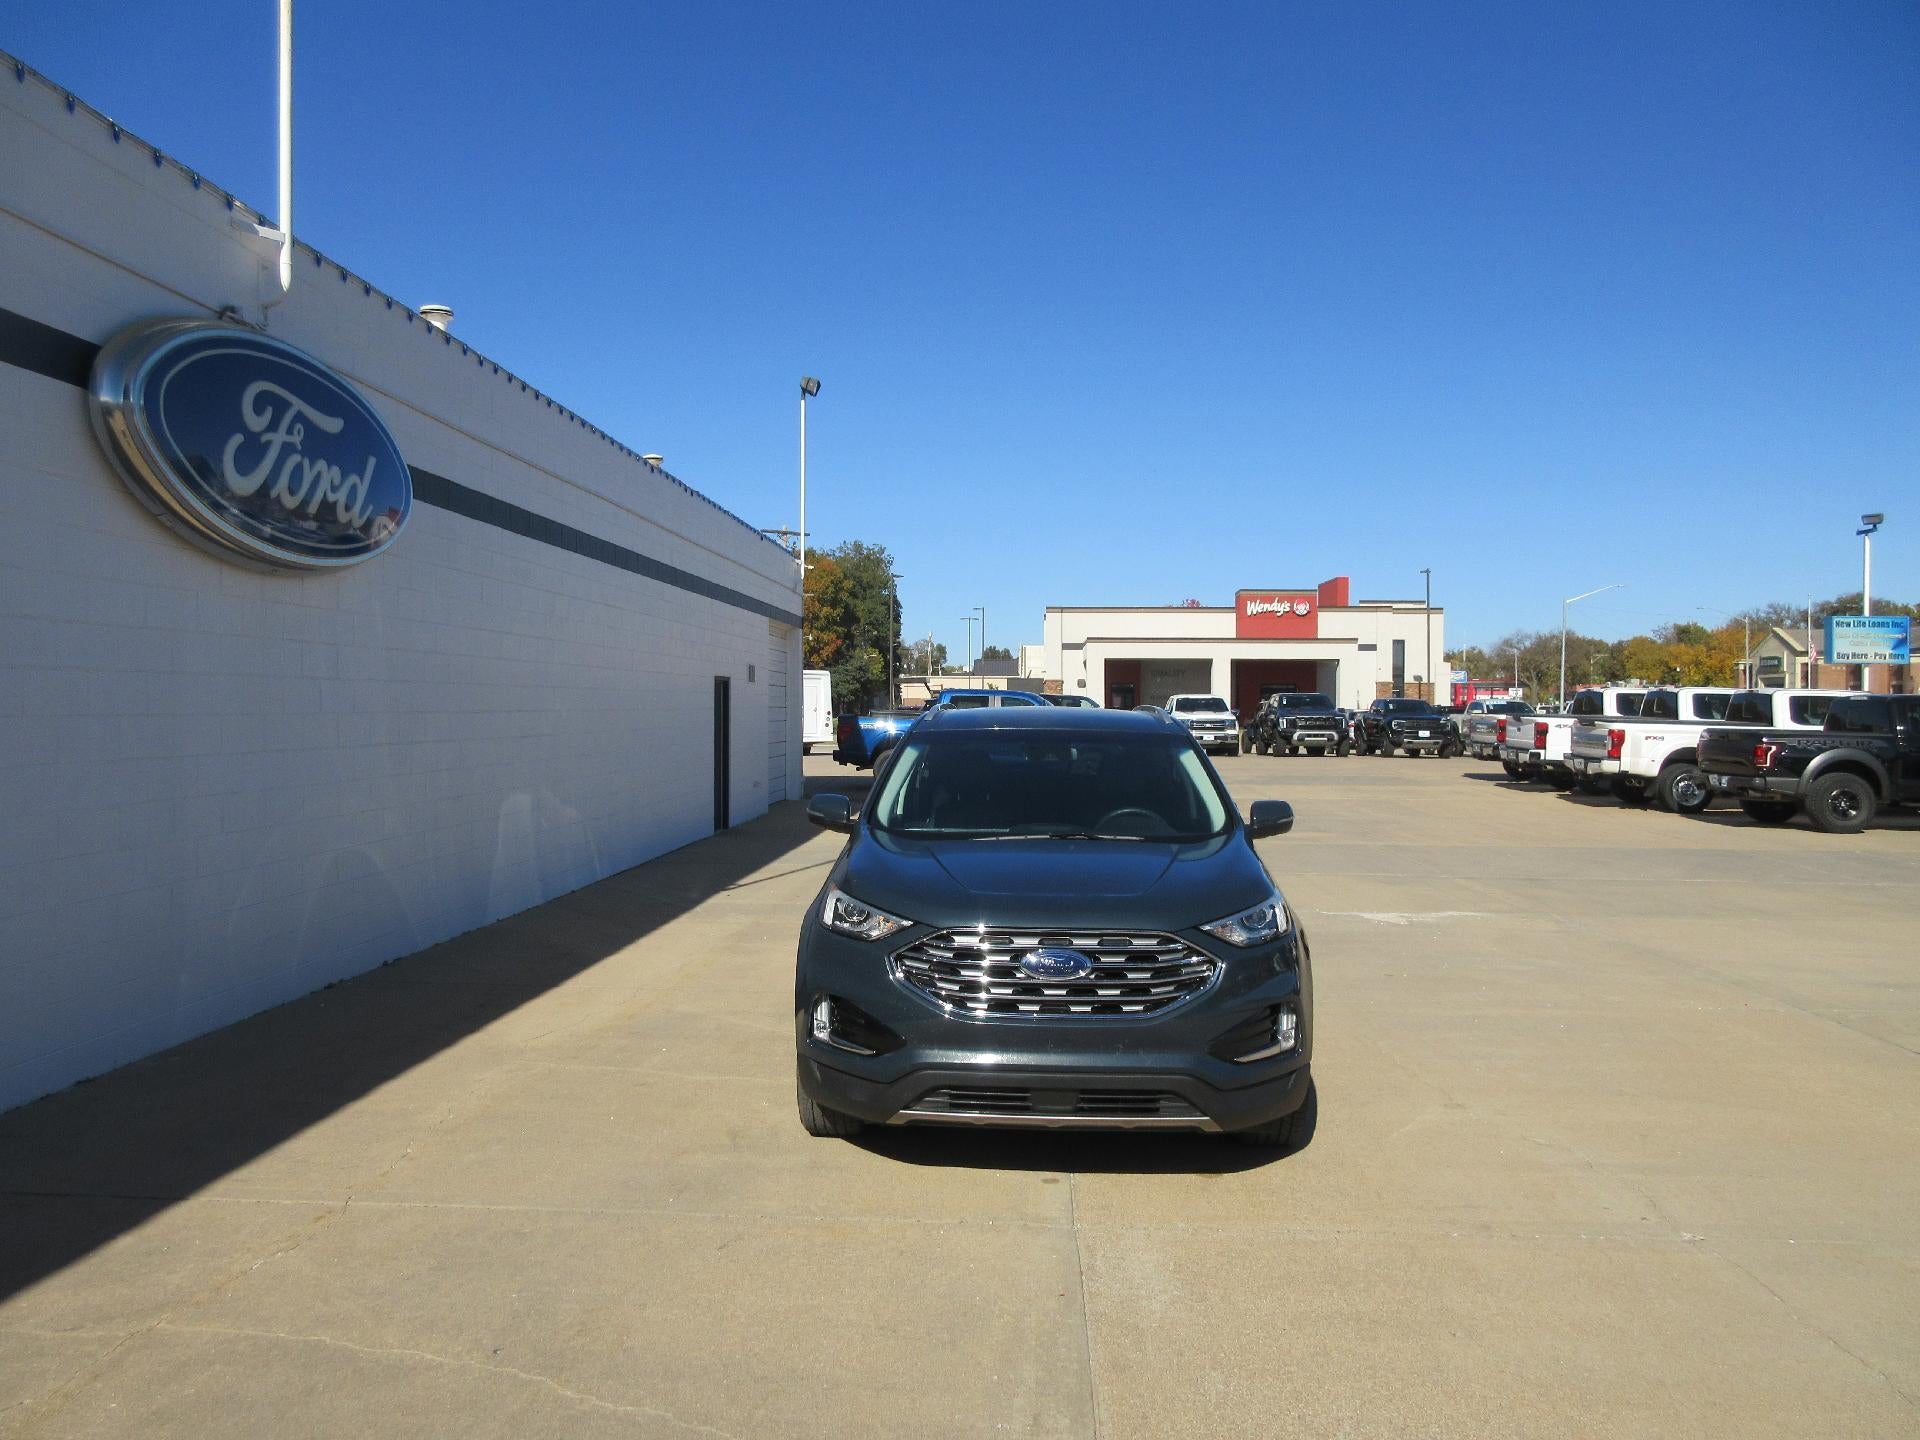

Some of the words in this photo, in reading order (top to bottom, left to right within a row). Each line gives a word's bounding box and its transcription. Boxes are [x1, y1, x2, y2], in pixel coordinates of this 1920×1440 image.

[223, 380, 377, 528] Ford
[1246, 597, 1291, 617] Wendy's
[1835, 620, 1851, 628] New
[1853, 620, 1867, 628] Life
[1868, 620, 1890, 628] Loans
[1836, 652, 1849, 660] Buy
[1851, 652, 1868, 660] Here
[1873, 652, 1887, 661] Pay
[1888, 652, 1905, 660] Here
